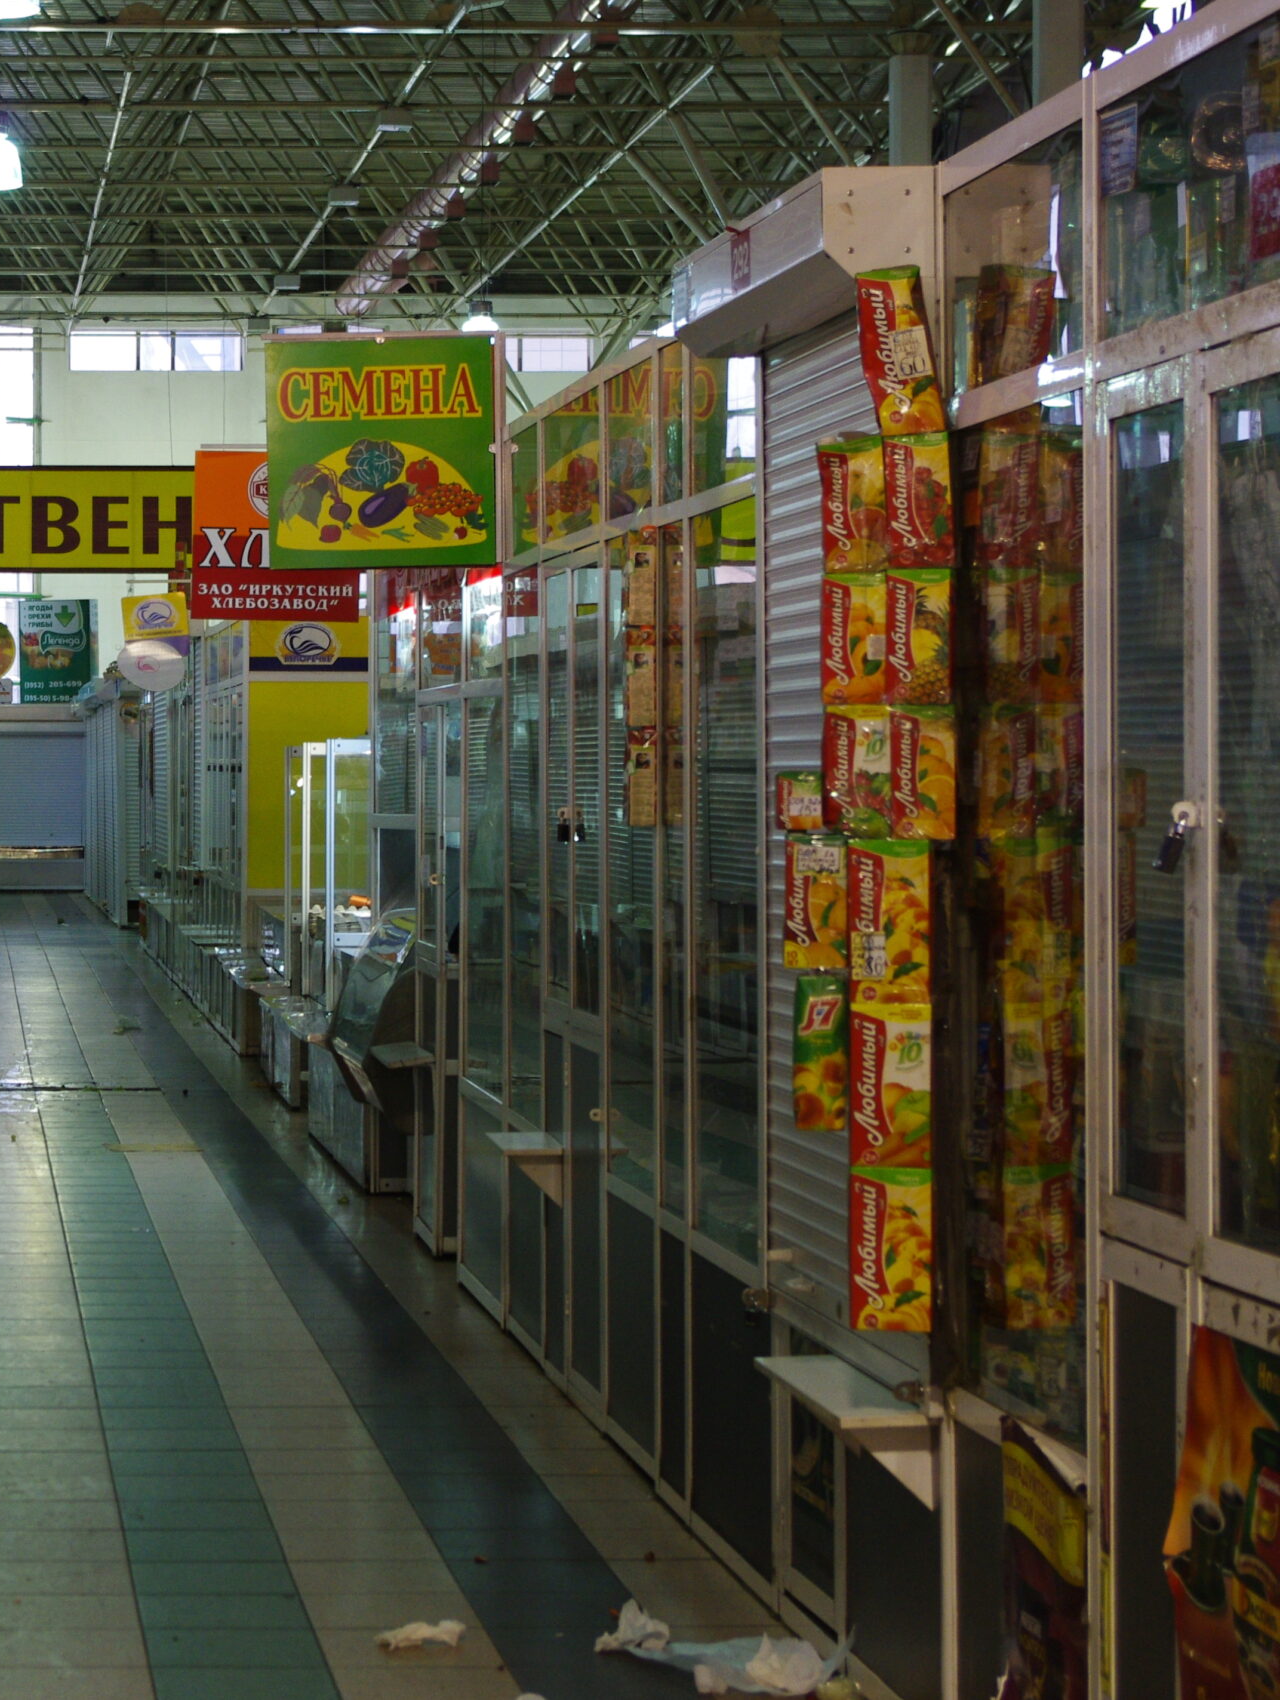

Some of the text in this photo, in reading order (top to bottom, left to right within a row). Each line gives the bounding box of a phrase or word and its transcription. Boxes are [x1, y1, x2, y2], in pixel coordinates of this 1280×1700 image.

[733, 242, 750, 281] 292
[278, 364, 482, 422] СЕМЕНА
[861, 287, 911, 413] Любимый
[822, 456, 852, 552] Любимый
[886, 446, 918, 549] Любимый
[198, 583, 234, 597] ЗАО
[200, 527, 270, 569] ХЛ
[825, 585, 851, 686] Любимый
[888, 582, 913, 683] Любимый
[893, 716, 918, 818] Любимый
[786, 875, 811, 947] Любим
[852, 855, 876, 933] бимый
[853, 1018, 884, 1148] Любимый
[853, 1182, 887, 1312] Любимый
